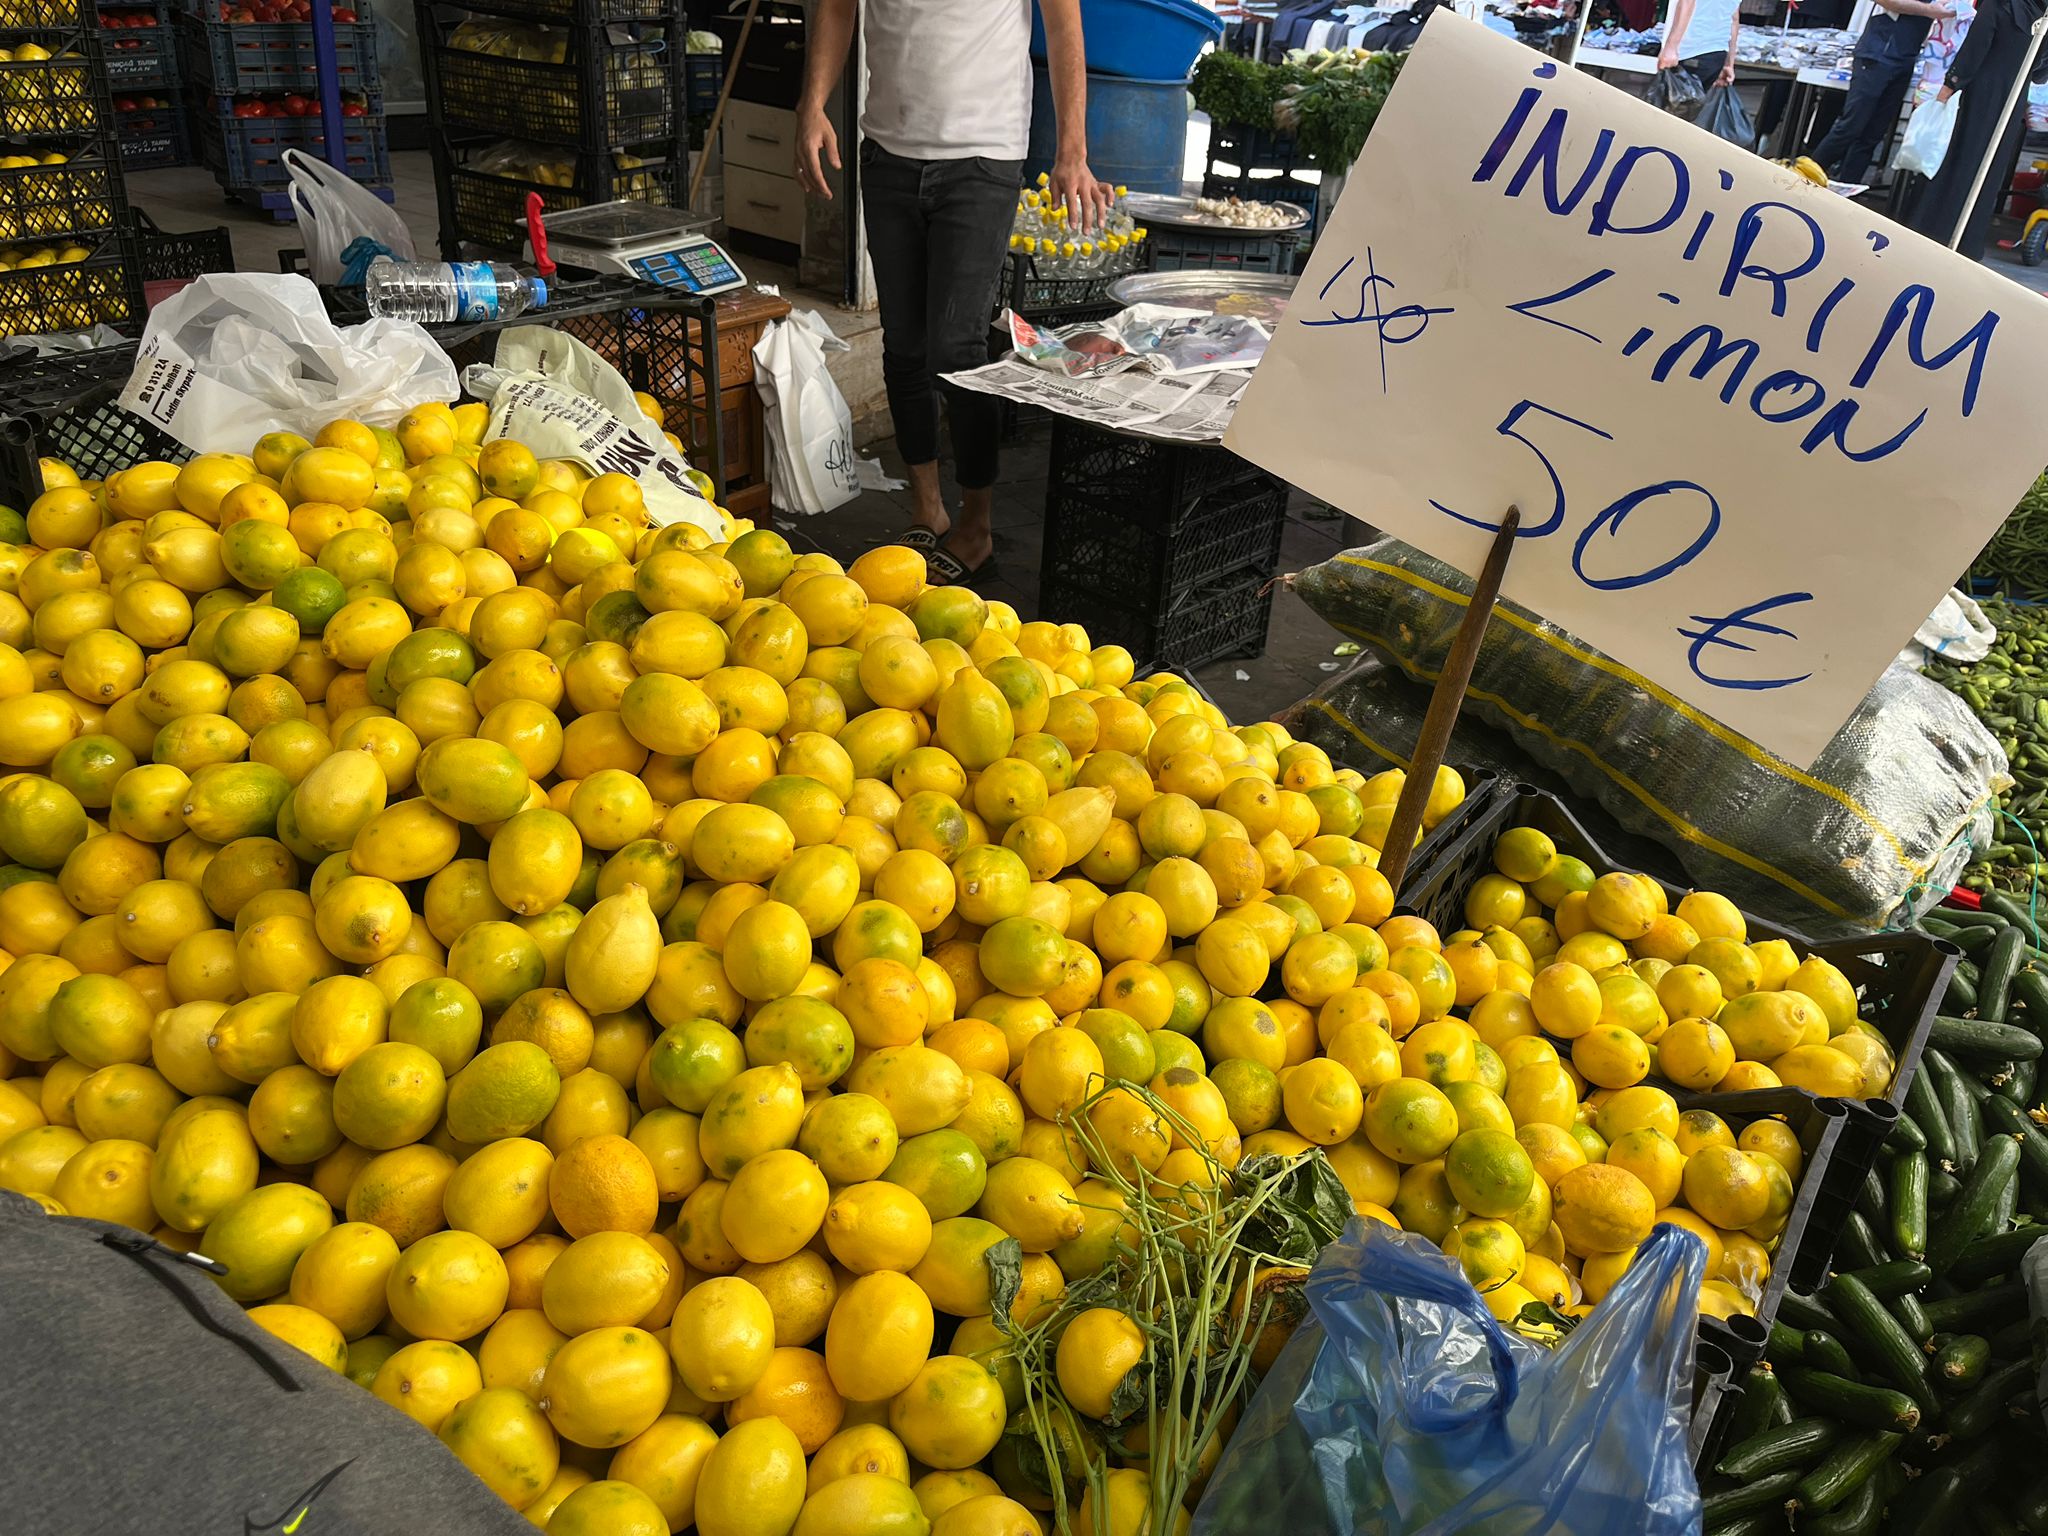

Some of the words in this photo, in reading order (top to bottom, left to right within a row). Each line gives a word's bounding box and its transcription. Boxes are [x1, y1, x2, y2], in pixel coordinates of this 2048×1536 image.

[175, 368, 197, 398] Skypark
[1429, 399, 1721, 590] 50
[1677, 592, 1814, 691] €
